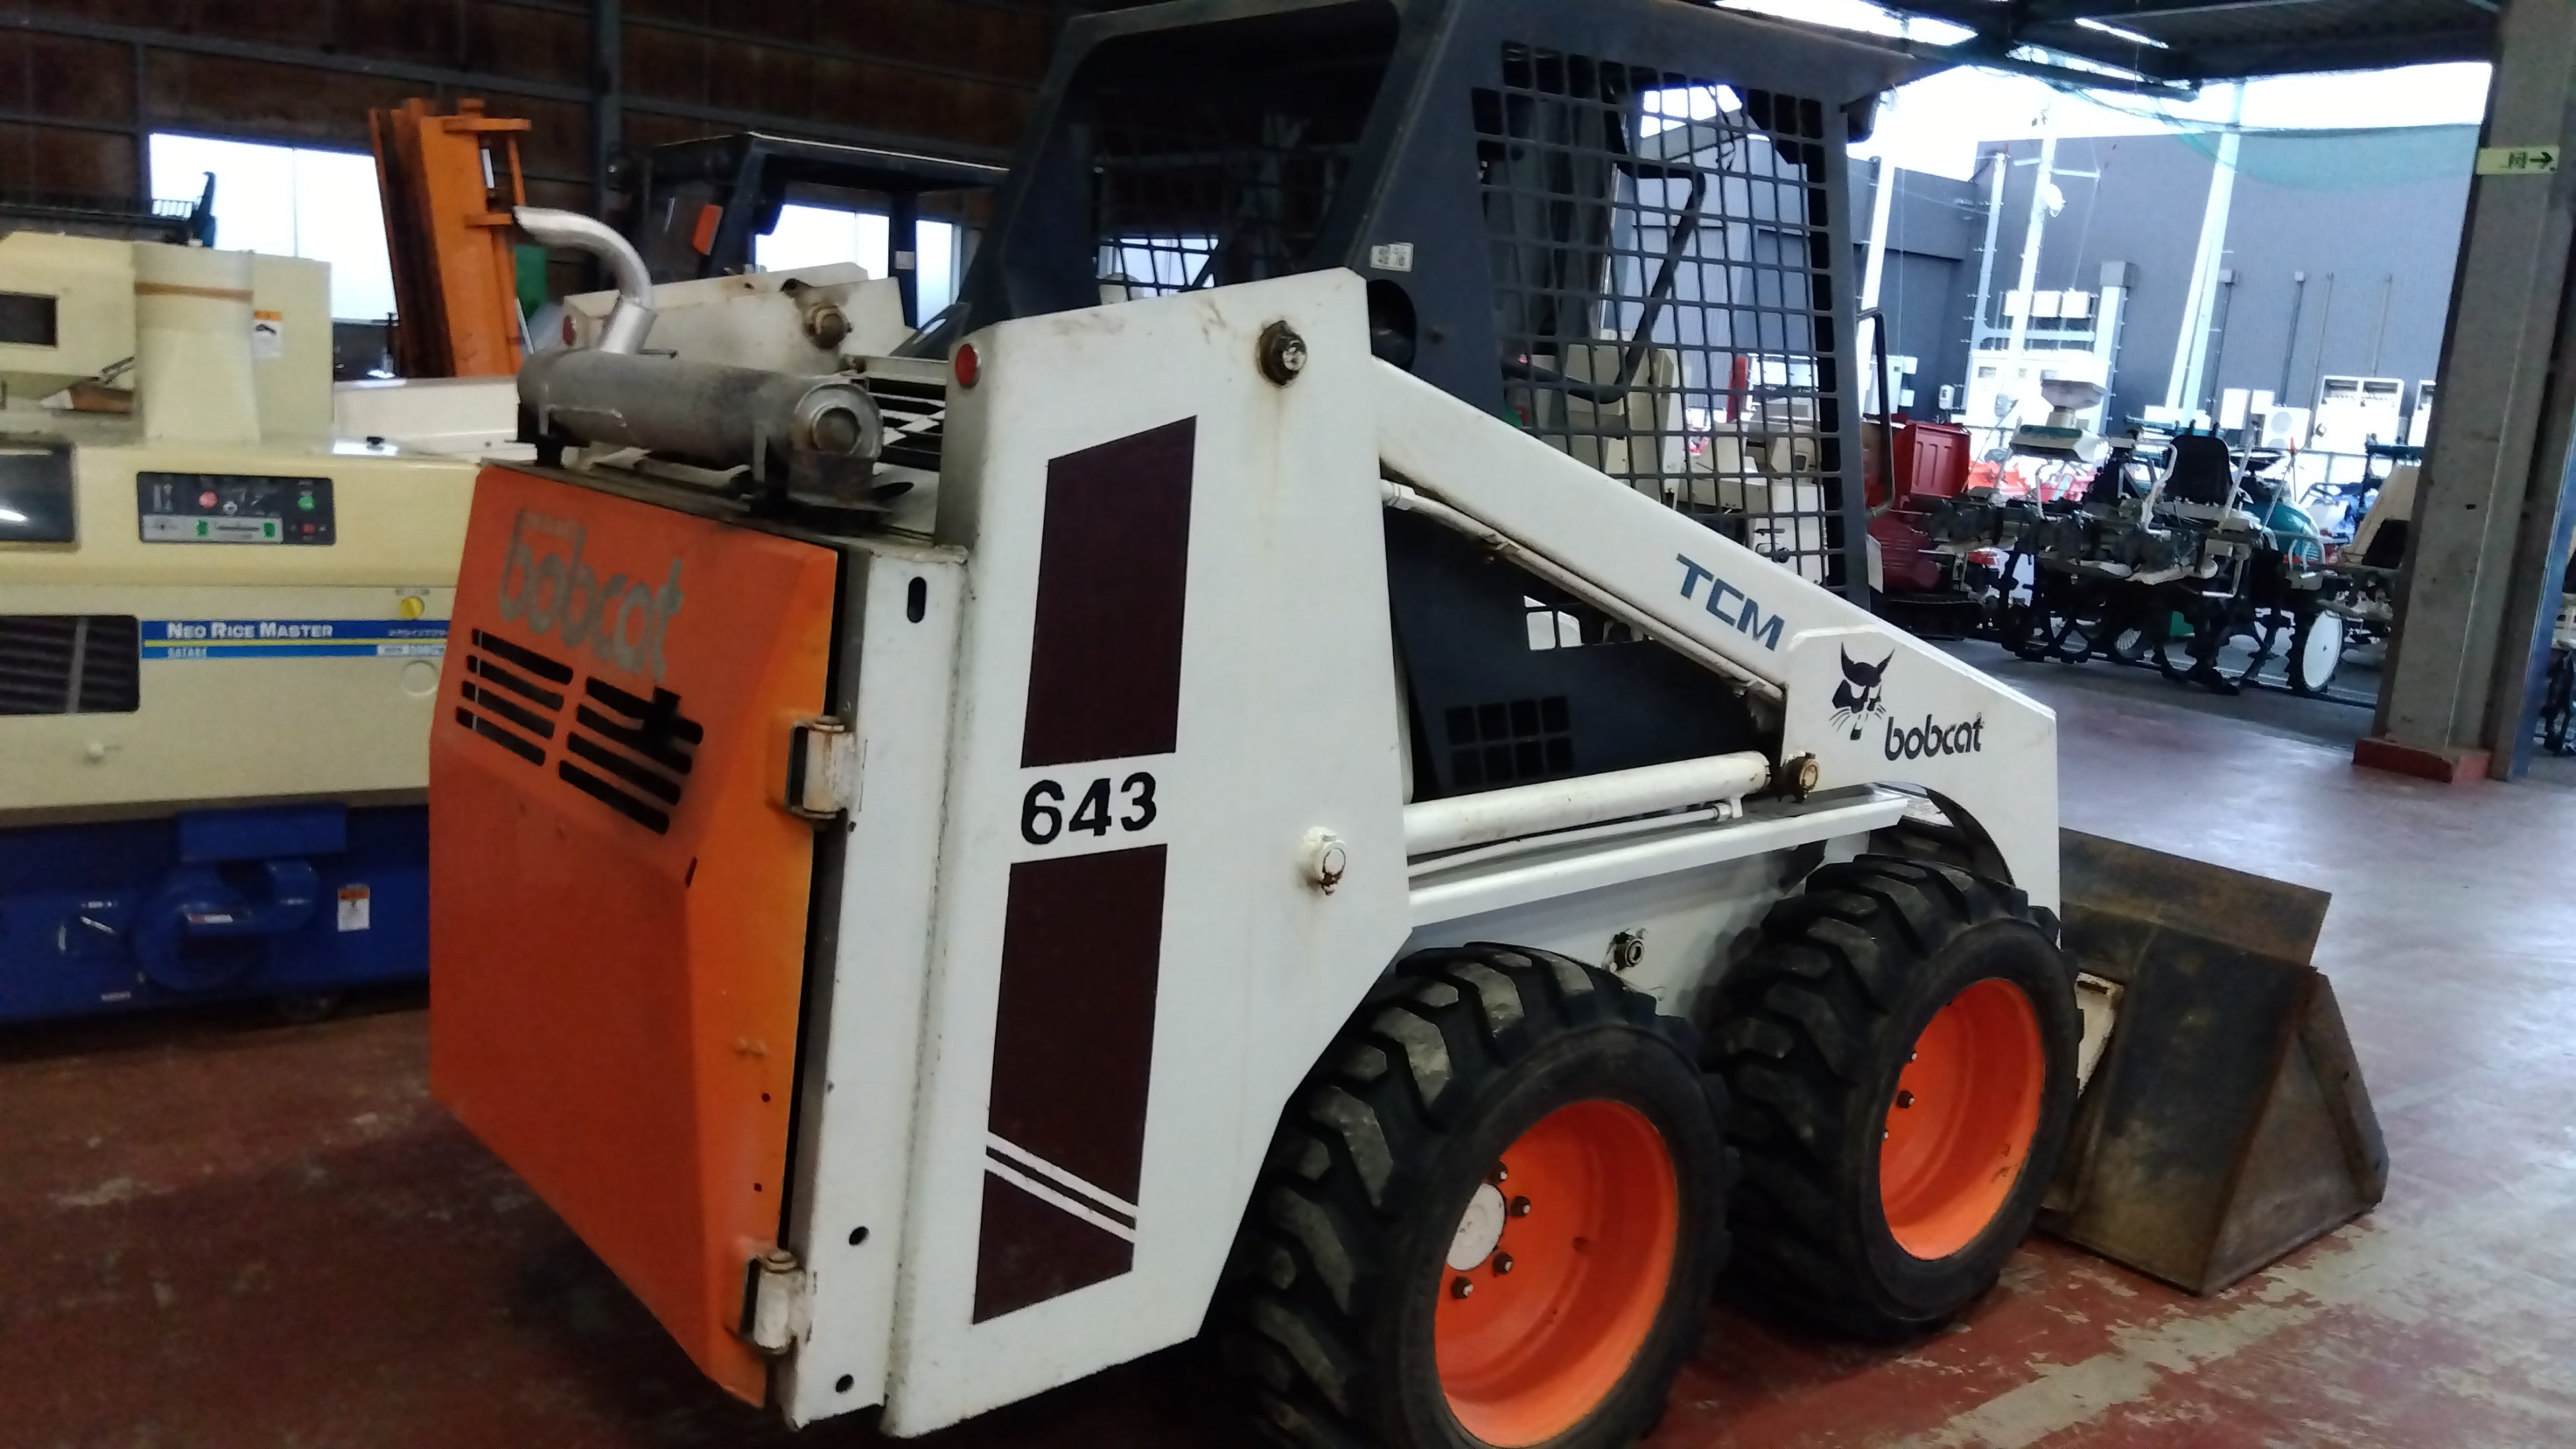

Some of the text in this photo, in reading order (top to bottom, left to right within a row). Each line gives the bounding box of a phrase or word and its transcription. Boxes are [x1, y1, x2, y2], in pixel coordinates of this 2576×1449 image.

[167, 622, 333, 638] NEO RICE MASTER
[498, 508, 684, 683] bobcat
[1676, 553, 1785, 651] TCM
[1884, 712, 1985, 761] bobcat
[1020, 771, 1157, 845] 643
